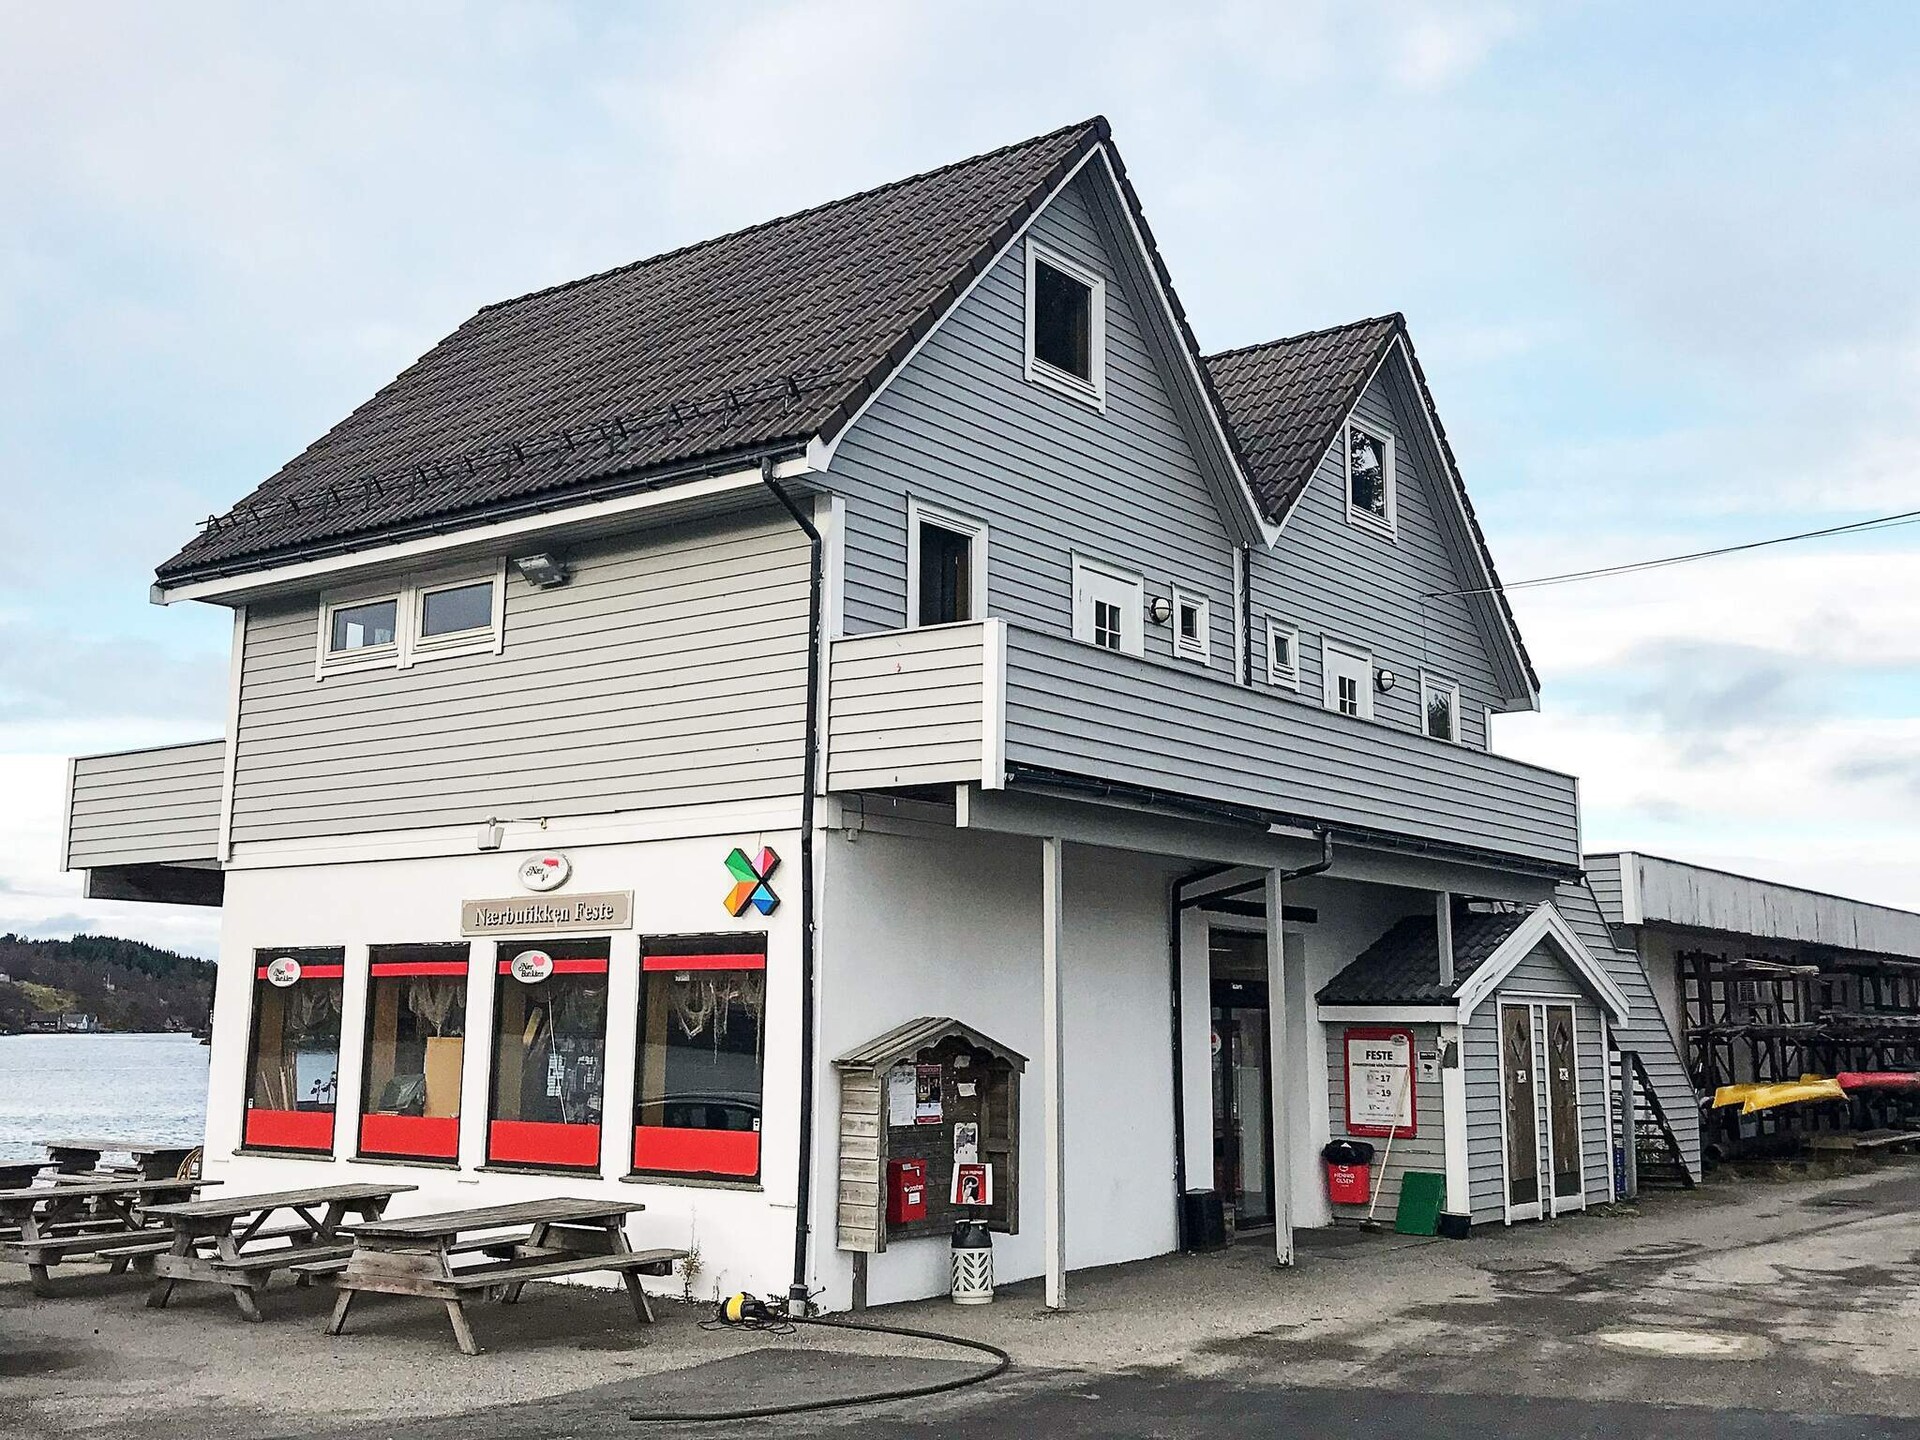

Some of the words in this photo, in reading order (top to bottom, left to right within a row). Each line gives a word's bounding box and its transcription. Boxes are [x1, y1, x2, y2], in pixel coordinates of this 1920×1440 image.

[475, 903, 570, 926] Nærbutikken
[574, 901, 614, 922] Feste
[1365, 1050, 1394, 1061] FESTE
